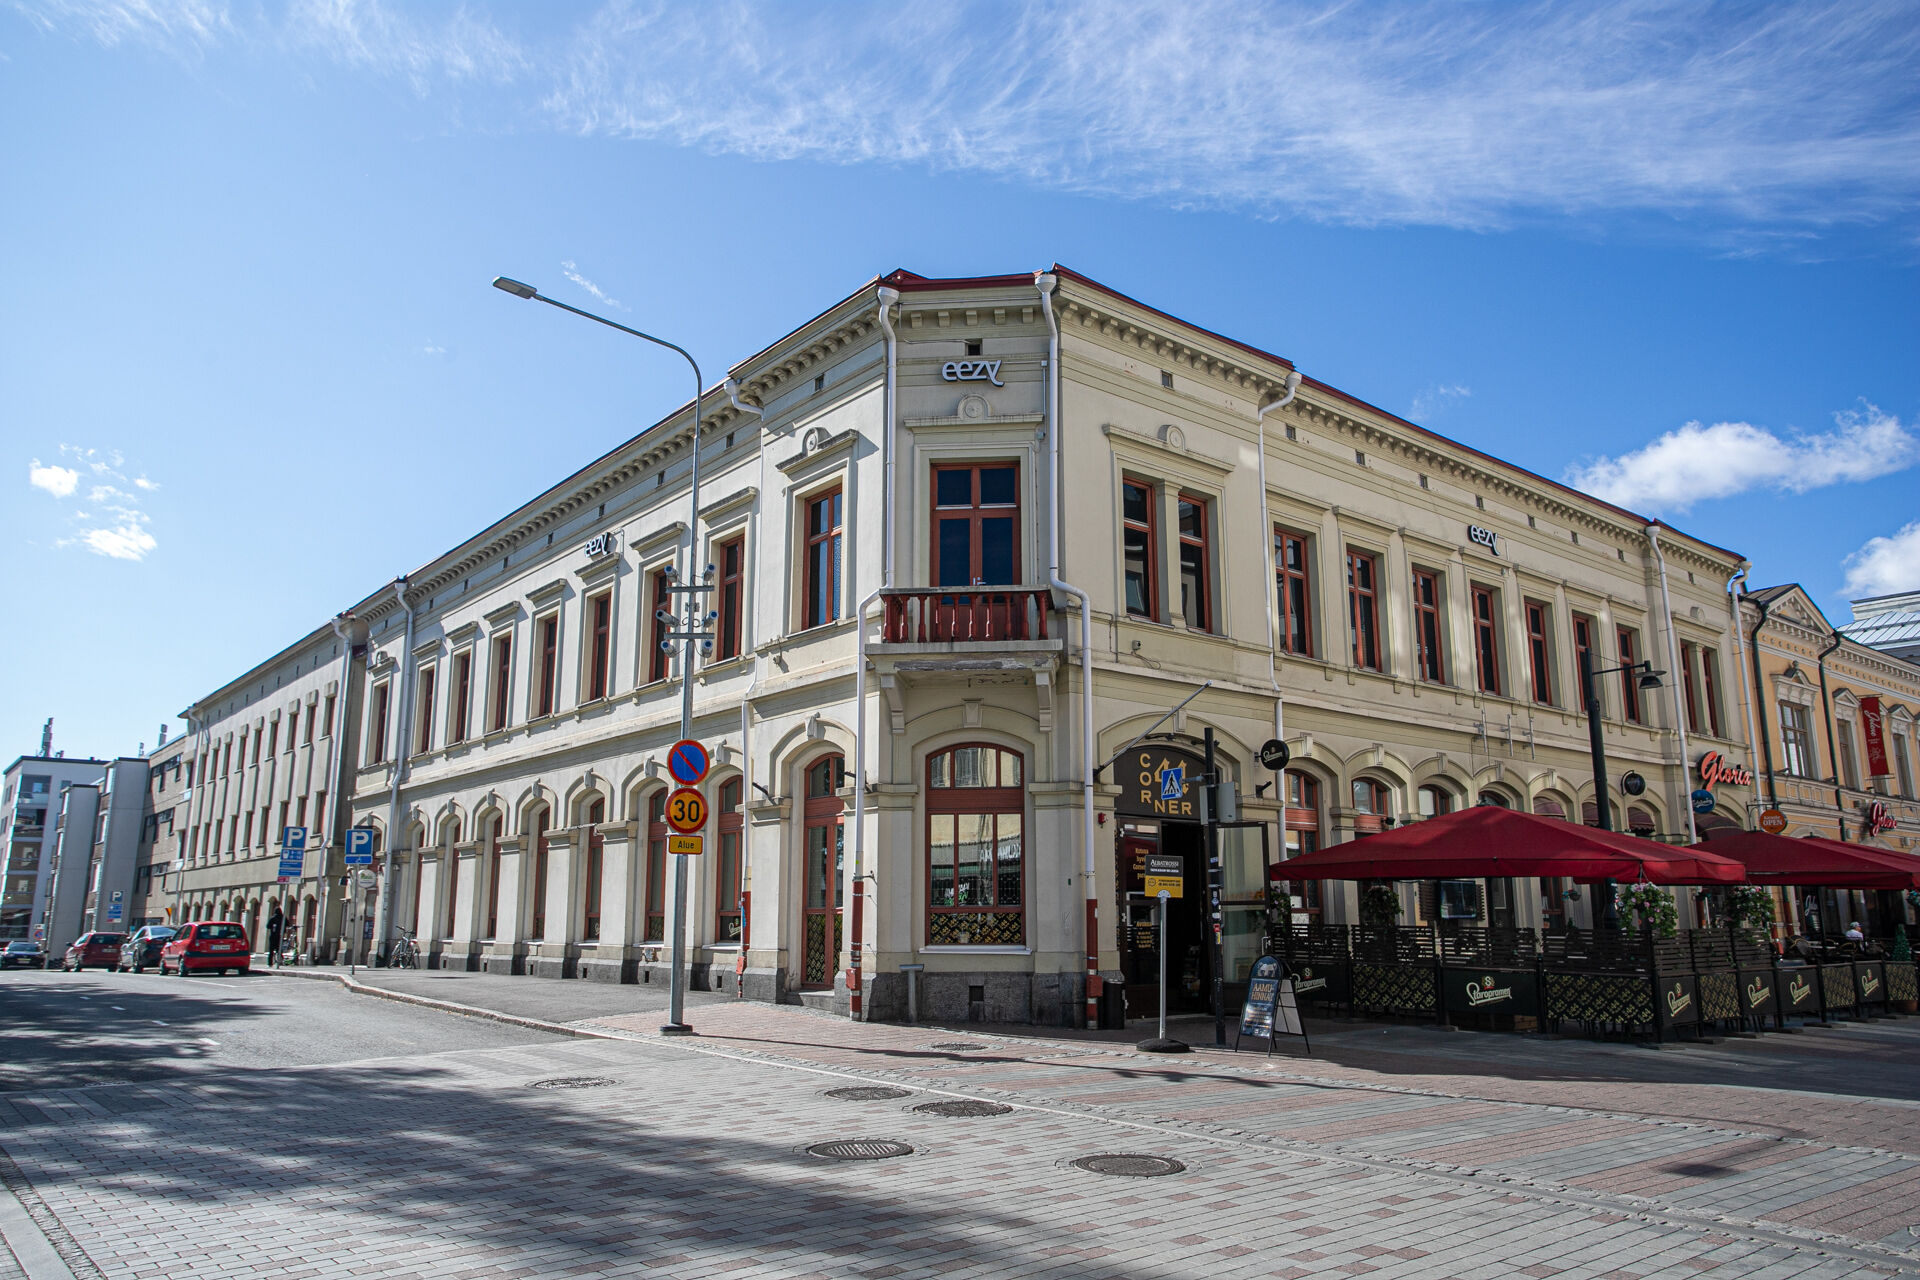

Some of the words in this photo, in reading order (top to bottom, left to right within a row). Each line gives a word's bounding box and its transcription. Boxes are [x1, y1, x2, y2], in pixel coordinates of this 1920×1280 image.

[942, 360, 1004, 387] eezy
[584, 532, 608, 558] eezy
[1468, 525, 1500, 556] eezy
[1700, 750, 1751, 792] Gloria
[673, 799, 700, 823] 30
[287, 828, 304, 847] P
[350, 831, 369, 853] P
[677, 840, 695, 849] Alue
[112, 891, 122, 902] P
[1466, 982, 1512, 1006] Staropramen
